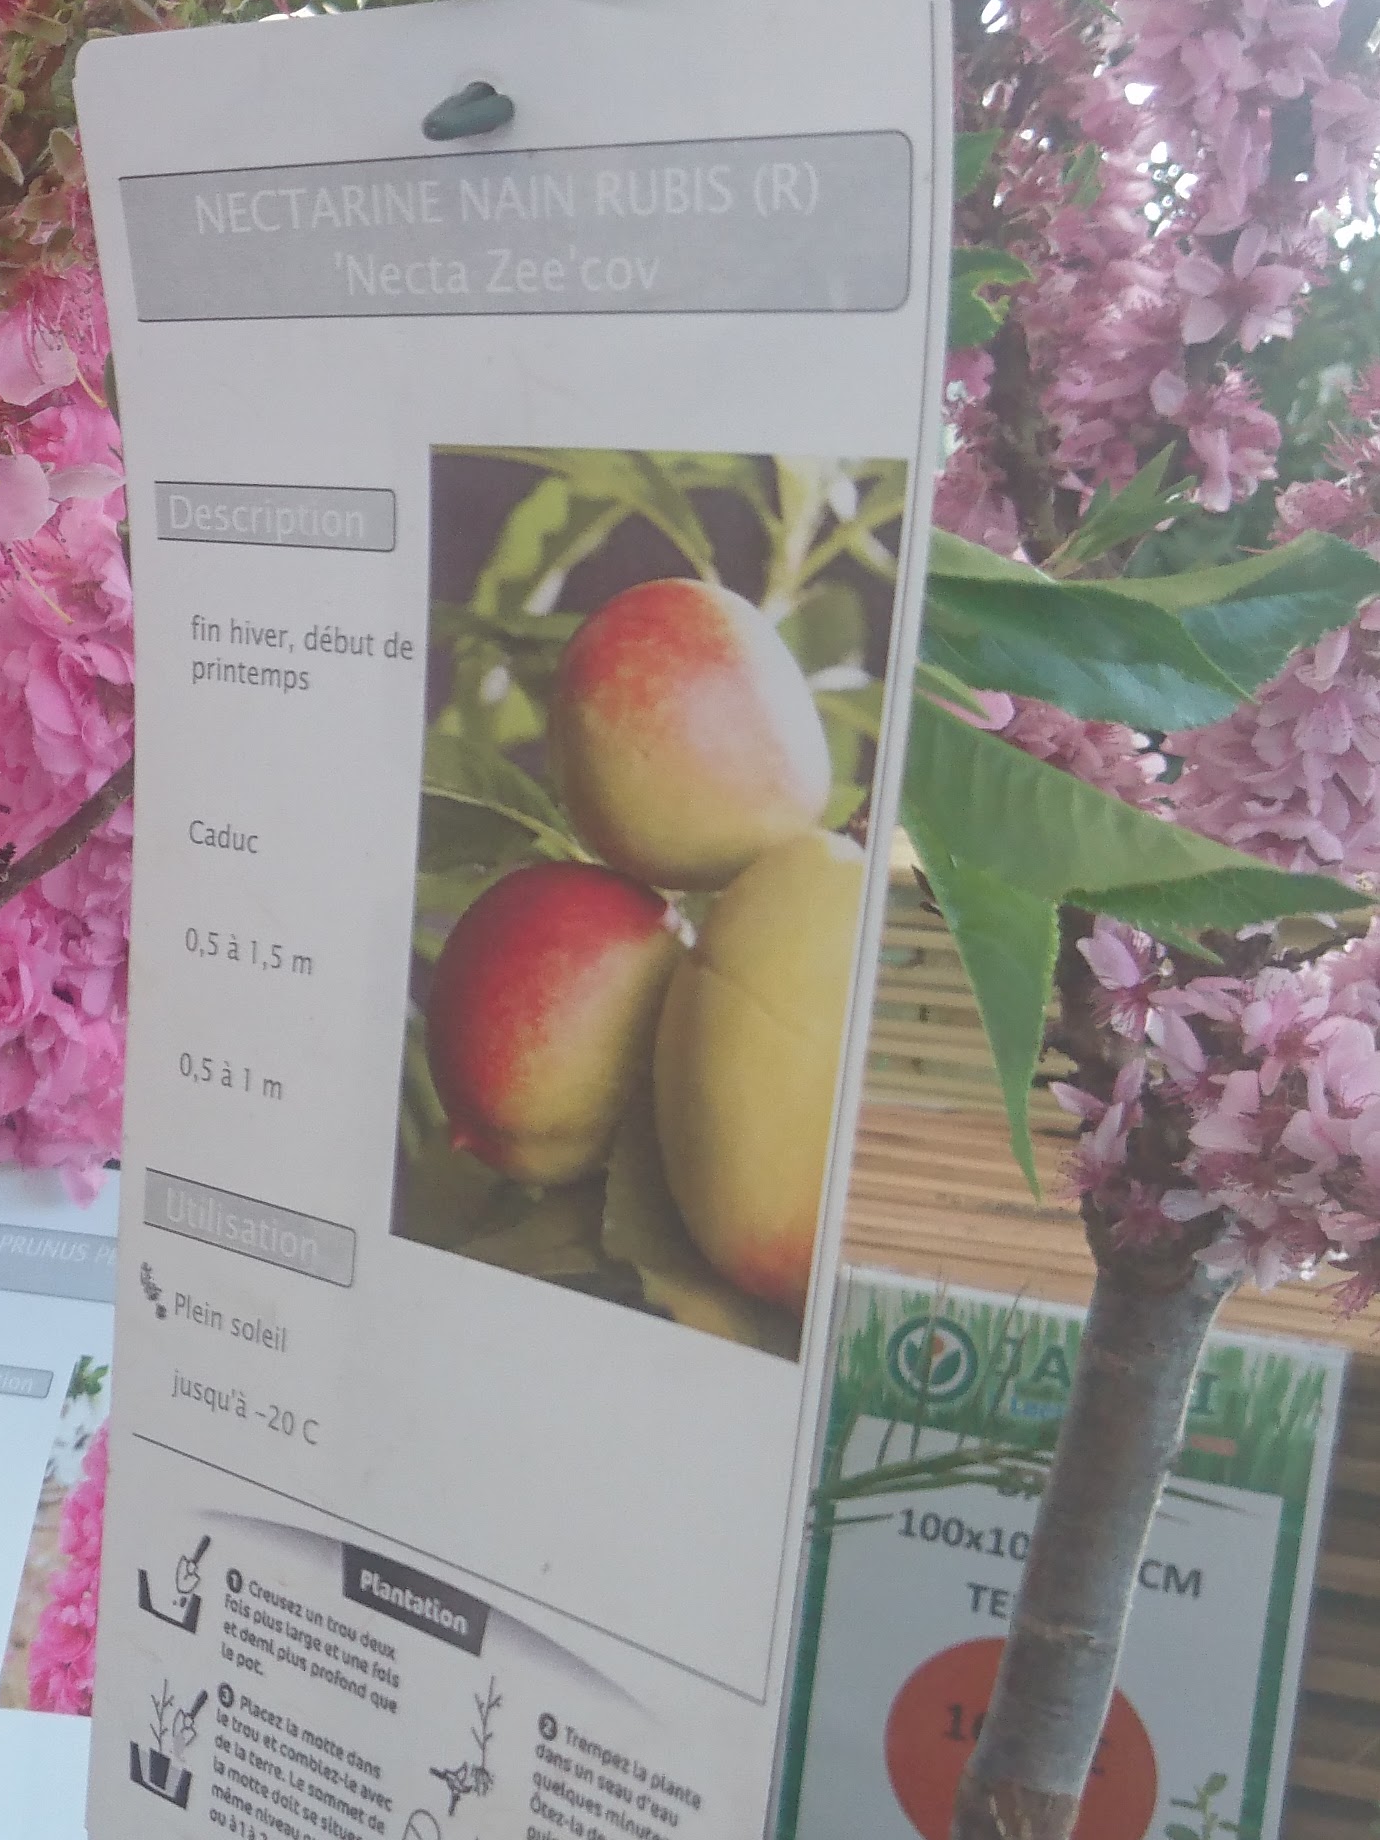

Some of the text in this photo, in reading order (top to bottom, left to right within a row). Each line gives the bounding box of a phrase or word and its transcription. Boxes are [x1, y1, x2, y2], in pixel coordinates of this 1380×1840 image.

[195, 160, 819, 234] NECTARINE NAIN RUBIS (R)
[169, 495, 365, 542] Description
[191, 615, 414, 660] fin hiver, début de
[192, 658, 309, 694] printemps
[190, 820, 258, 854] Caduc
[185, 928, 313, 975] 0,5 à 1,5 m
[180, 1052, 282, 1100] 0,5 à 1 m
[167, 1187, 319, 1261] Utilisation
[174, 1292, 287, 1352] Plein soleil
[172, 1368, 247, 1419] jusqu'à
[303, 1419, 320, 1445] C
[360, 1570, 469, 1636] Plantation
[1140, 1560, 1202, 1597] CM
[221, 1643, 233, 1660] le
[248, 1580, 303, 1617] Creusez
[306, 1609, 323, 1627] un
[327, 1616, 357, 1641] trou
[360, 1632, 396, 1660] deux
[253, 1610, 283, 1634] plus
[286, 1617, 321, 1651] large
[324, 1642, 339, 1660] et
[342, 1650, 368, 1674] une
[372, 1662, 400, 1688] fois
[223, 1621, 398, 1714] et demi plus profond que
[216, 1709, 392, 1811] le trou et comblez-le avec
[240, 1695, 283, 1730] Placez
[286, 1717, 298, 1738] la
[301, 1728, 344, 1760] motte
[347, 1749, 382, 1779] dans
[211, 1784, 252, 1816] même
[213, 1756, 224, 1775] la
[228, 1768, 269, 1799] motte
[272, 1789, 300, 1815] doit
[302, 1805, 318, 1826] se
[214, 1734, 386, 1835] de la terre. Le sommet de
[210, 1808, 226, 1827] ou
[230, 1814, 237, 1832] à
